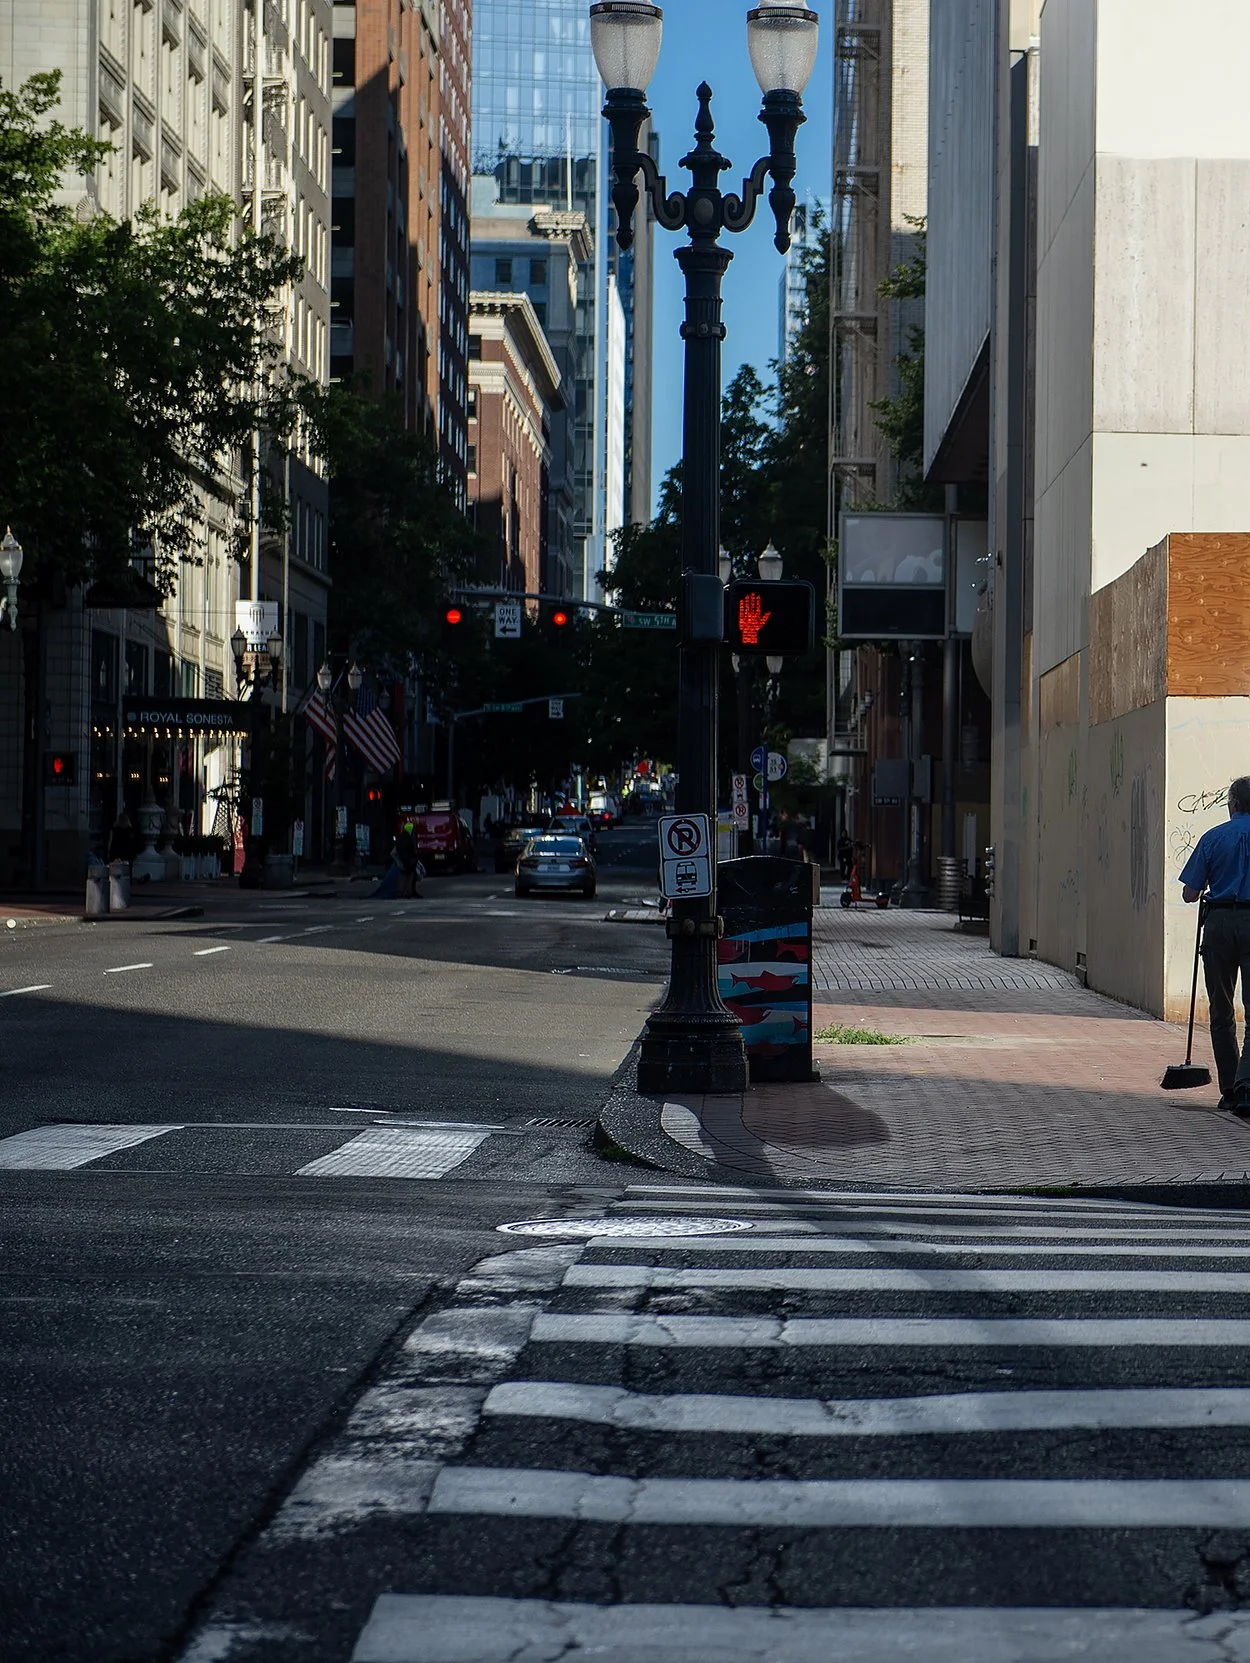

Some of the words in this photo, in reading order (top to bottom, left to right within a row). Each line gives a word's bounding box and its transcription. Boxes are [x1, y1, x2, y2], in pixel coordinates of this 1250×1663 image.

[500, 609, 516, 617] ONE
[639, 618, 651, 626] SW
[140, 711, 183, 724] ROYAL
[186, 712, 234, 726] SONESTA
